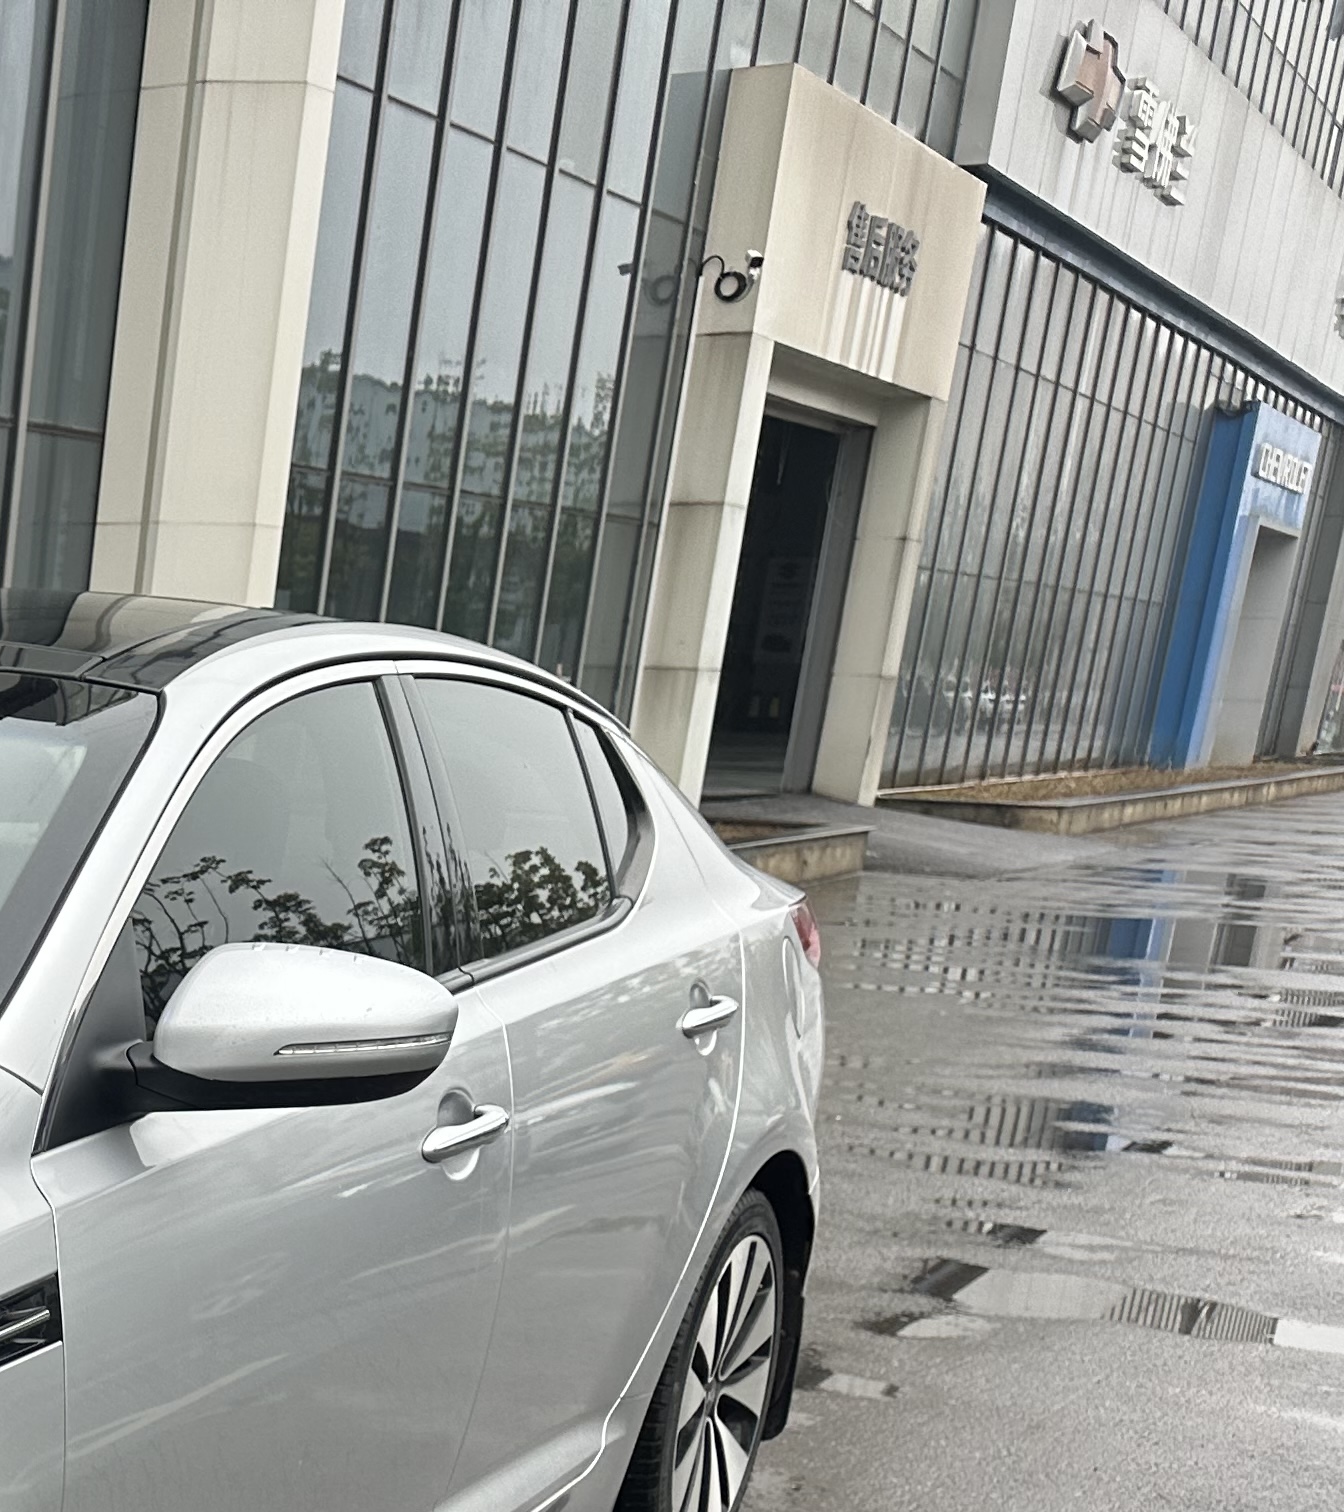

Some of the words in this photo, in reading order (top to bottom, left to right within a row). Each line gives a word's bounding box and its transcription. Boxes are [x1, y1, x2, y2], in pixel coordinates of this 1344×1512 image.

[842, 201, 920, 297] 售后服务
[1258, 442, 1313, 494] CHEVROLET
